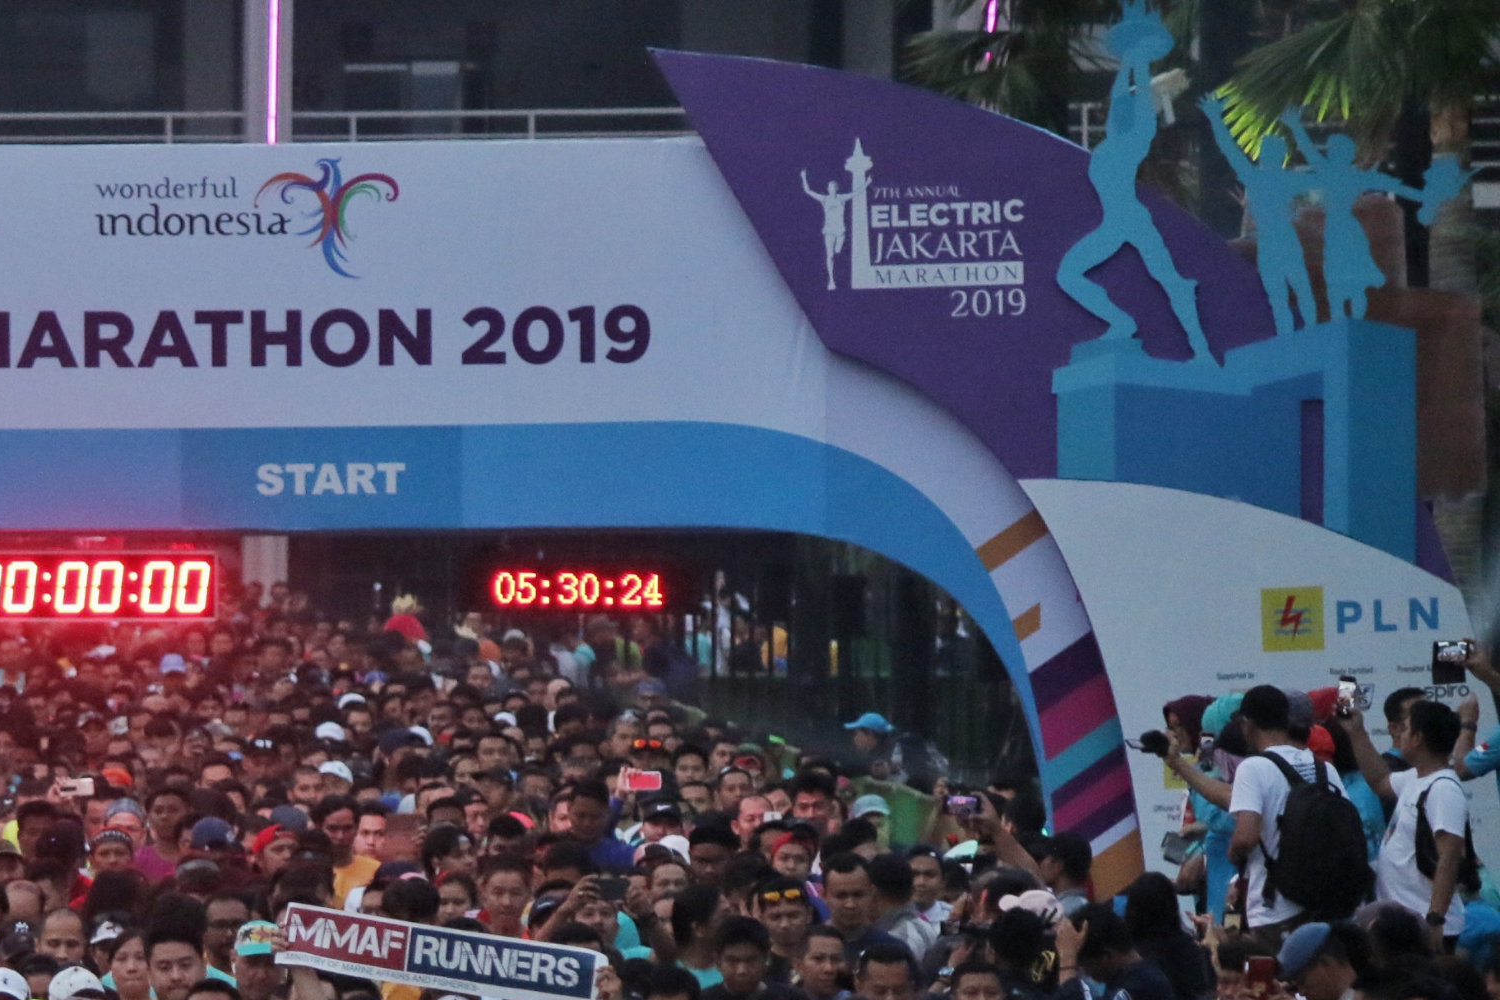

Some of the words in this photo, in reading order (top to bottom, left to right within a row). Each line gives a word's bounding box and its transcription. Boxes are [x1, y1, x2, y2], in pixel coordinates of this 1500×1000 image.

[95, 176, 239, 201] wonderful
[873, 186, 901, 199] 7TH
[903, 184, 962, 198] ANNUAL
[94, 202, 293, 238] indonesia
[870, 198, 1026, 229] ELECTRIC
[874, 229, 1023, 264] JAKARTA
[874, 264, 1018, 285] MARATHON
[950, 287, 1027, 318] 2019
[460, 303, 653, 365] 2019
[255, 461, 406, 496] START
[493, 571, 664, 606] 05:30:24
[1336, 597, 1440, 635] PLN
[1424, 684, 1470, 702] spiro
[288, 913, 406, 960] MMAF
[413, 934, 581, 988] RUNNERS
[327, 959, 341, 969] OF
[342, 962, 375, 975] MARINE
[376, 968, 411, 982] AFFAIRS
[412, 974, 433, 985] AND
